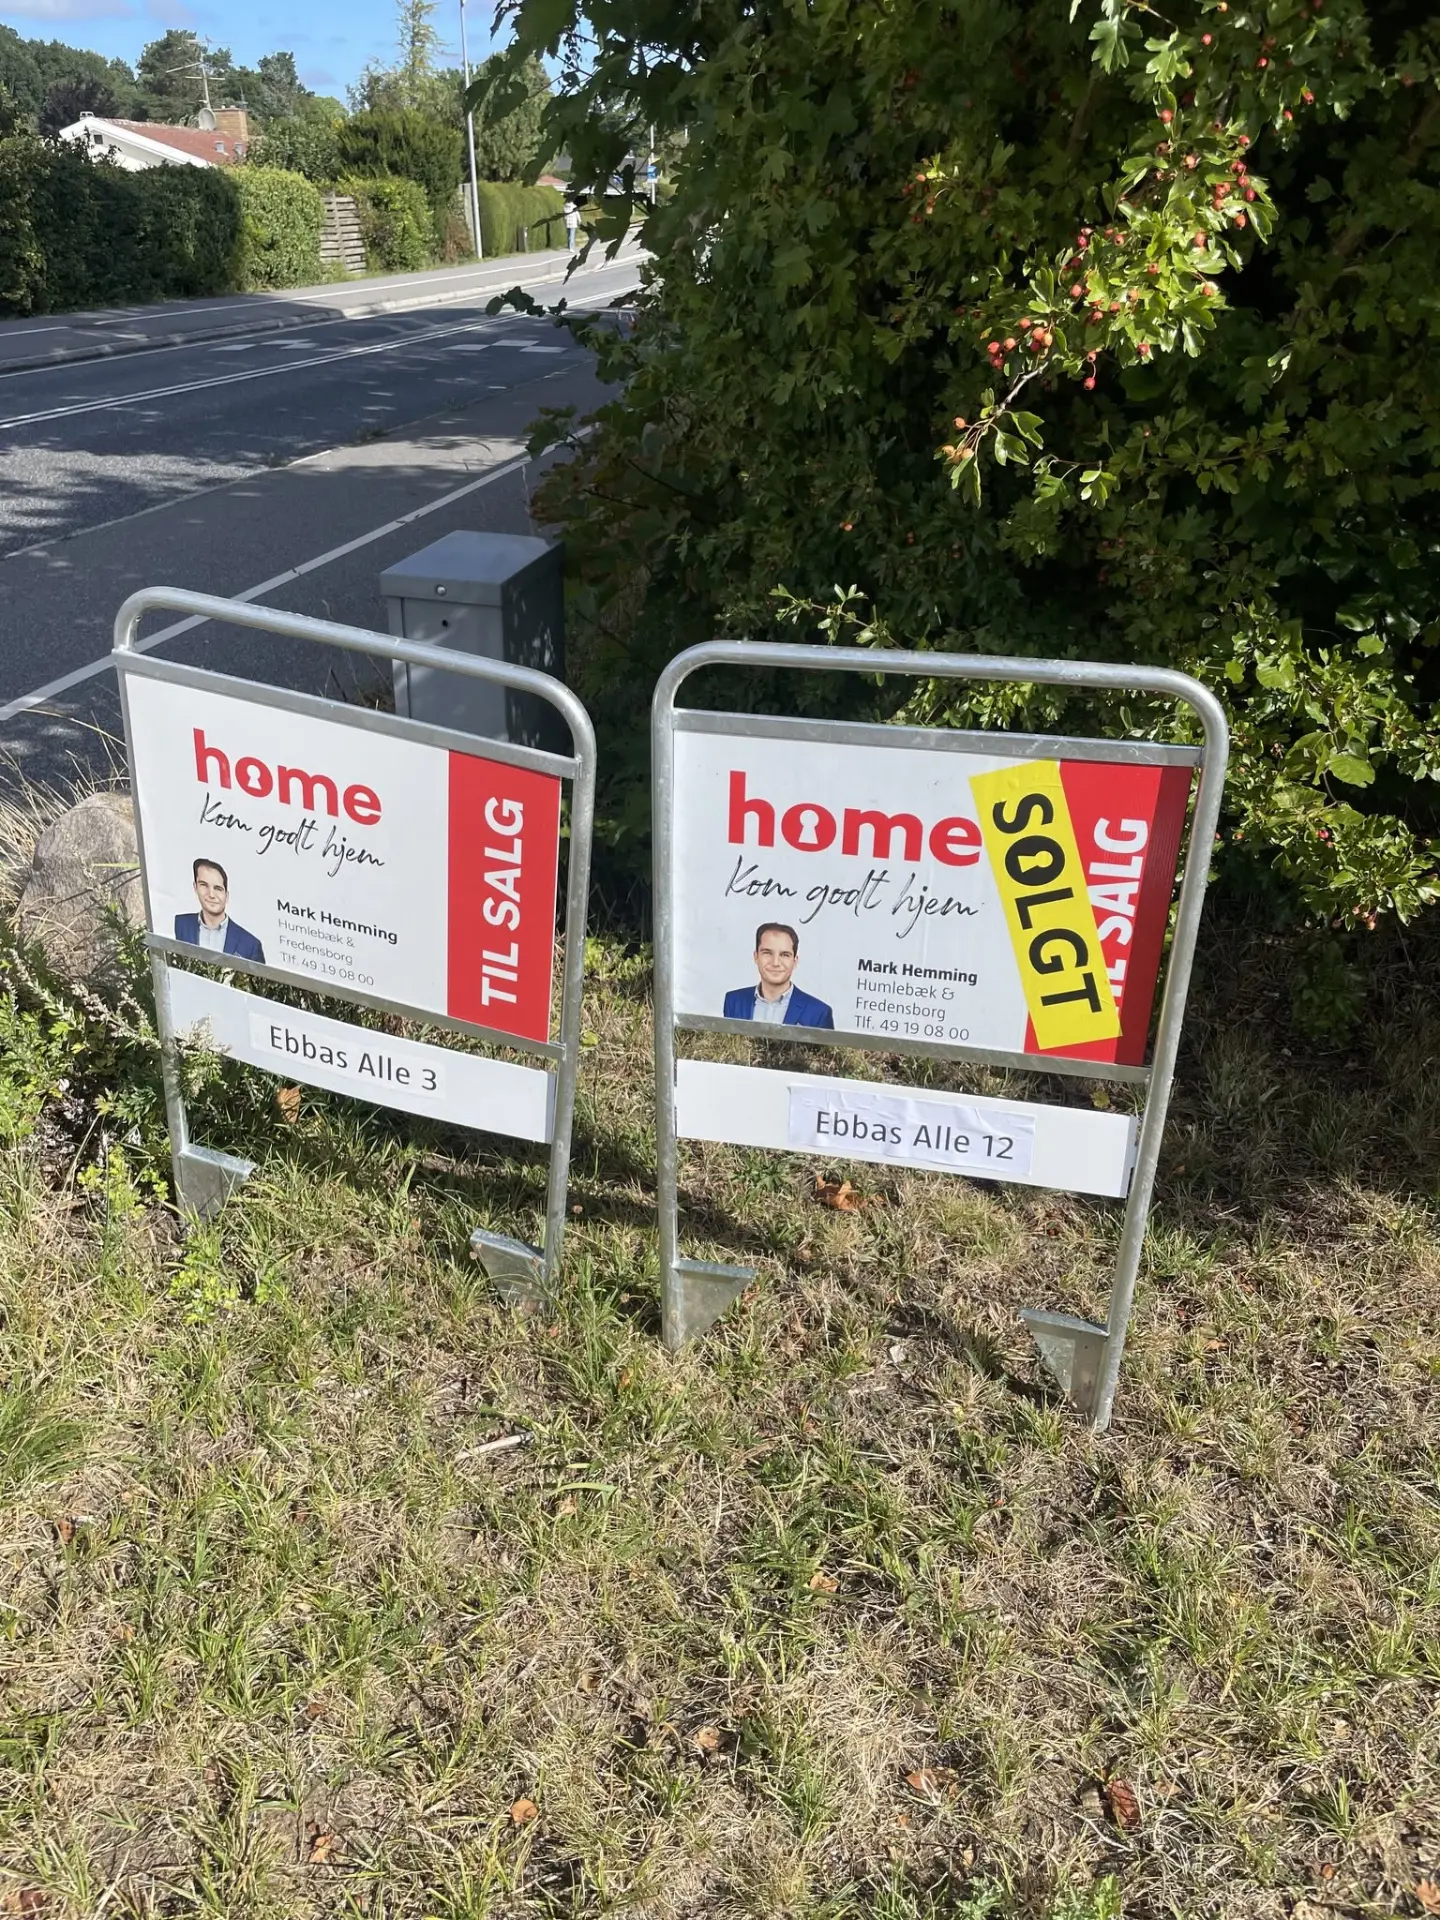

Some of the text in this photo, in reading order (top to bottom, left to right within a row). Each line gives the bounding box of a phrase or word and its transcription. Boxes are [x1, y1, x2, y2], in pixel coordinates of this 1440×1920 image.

[193, 727, 382, 826] home
[200, 792, 385, 878] Kom godt hjem
[728, 770, 983, 867] home
[481, 796, 524, 1006] TIL SALG
[725, 855, 978, 939] Kom godt hjem
[992, 793, 1103, 1013] SOLGT
[277, 899, 398, 945] Mark Hemming
[278, 918, 356, 948] Humlebæk &
[279, 935, 353, 966] Fredensborg
[280, 951, 374, 986] Tlf. 49 19 08 00
[857, 958, 978, 986] Mark Hemming
[855, 996, 946, 1022] Fredensborg
[857, 977, 955, 1000] Humlebæk &
[854, 1014, 970, 1041] Tlf. 49 19 08 00
[270, 1025, 437, 1091] Ebbas Alle 3
[816, 1110, 1014, 1160] Ebbas Alle 12
